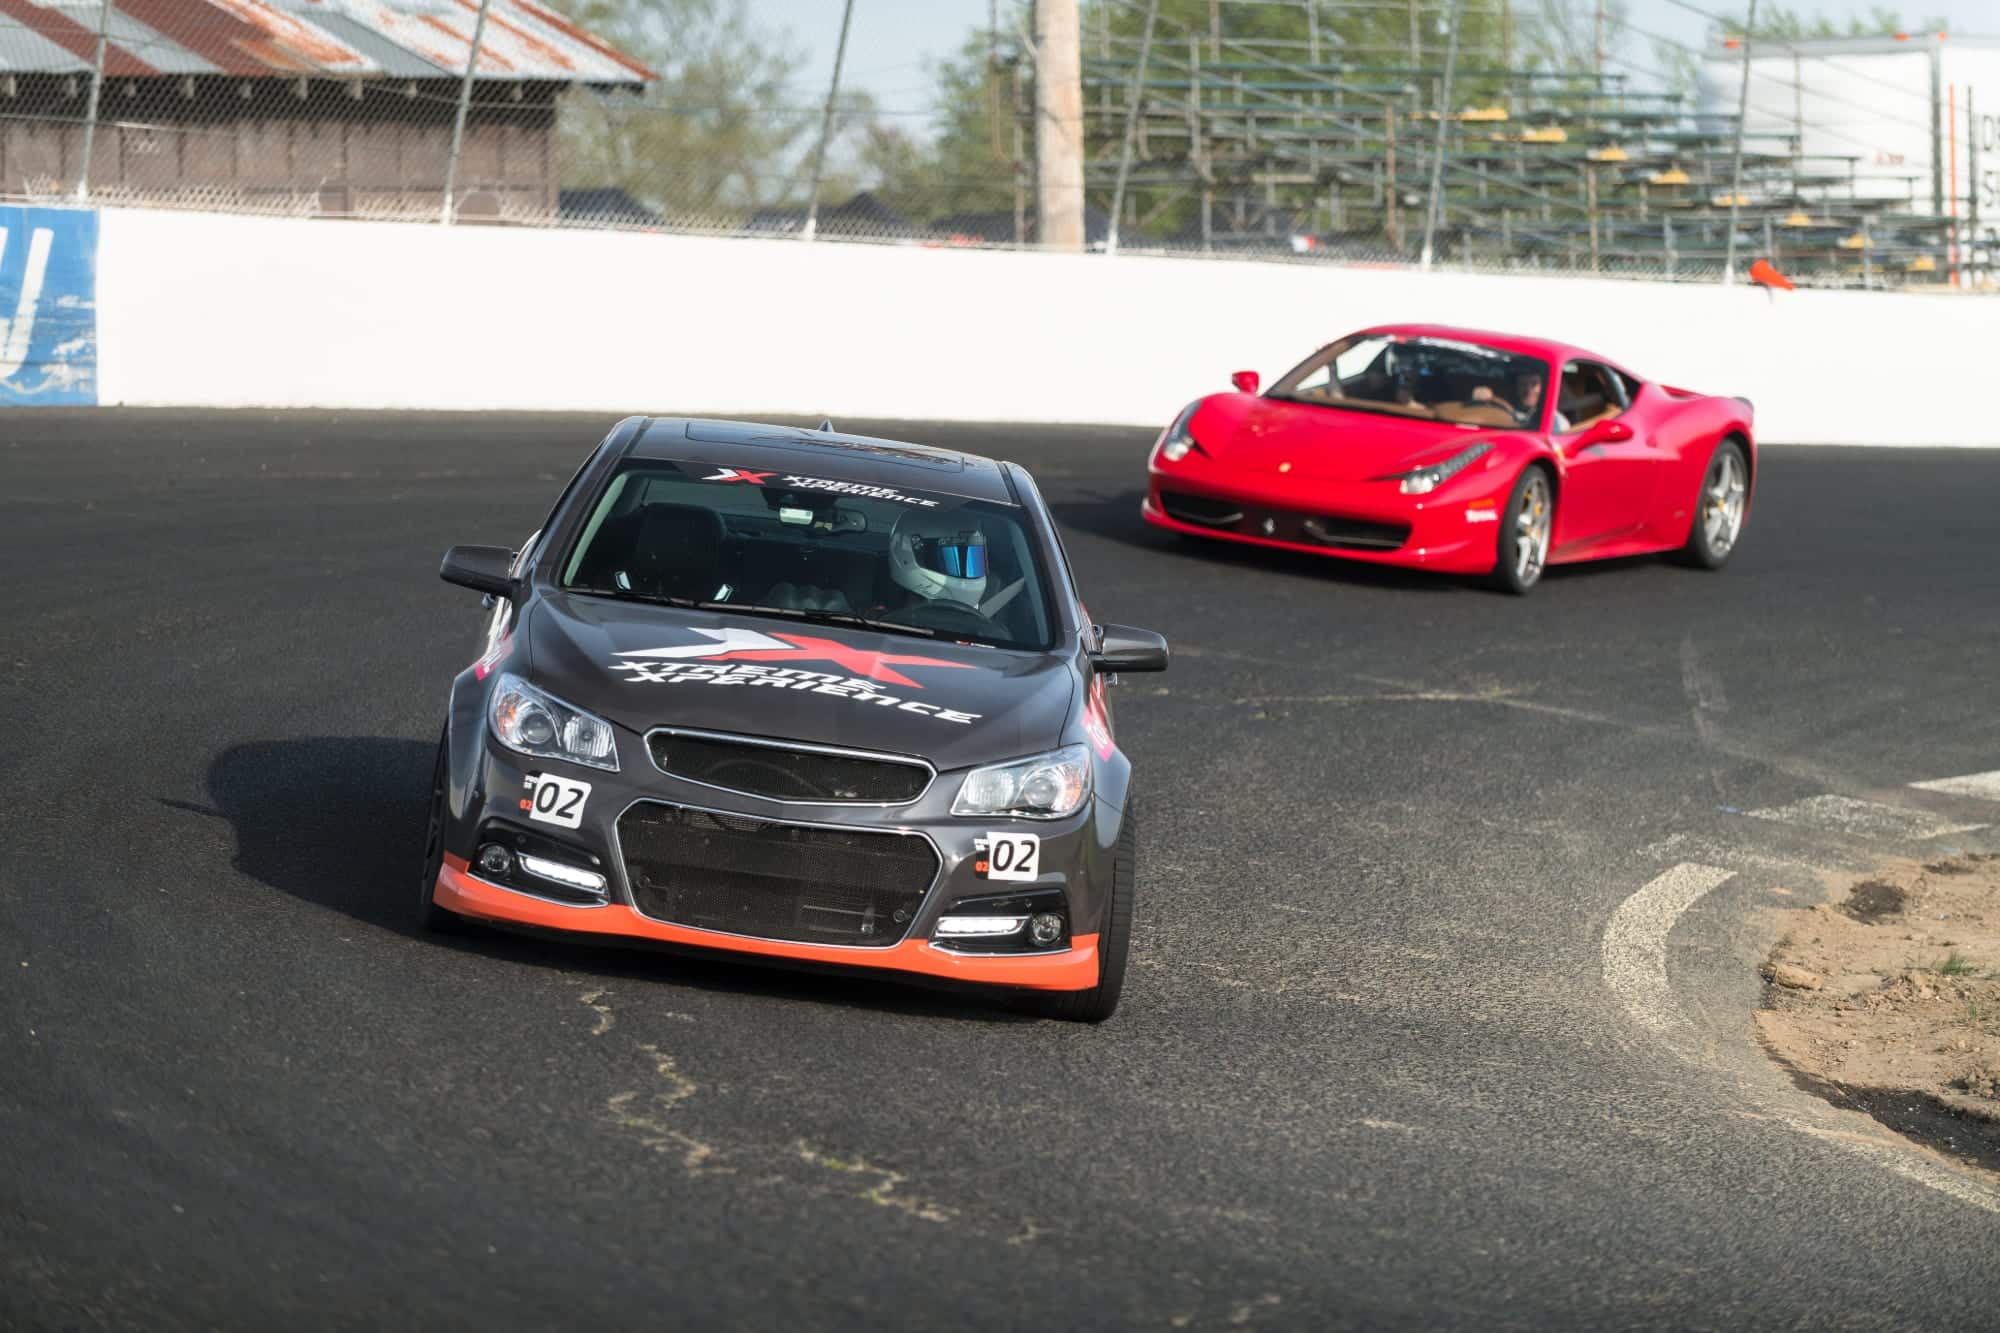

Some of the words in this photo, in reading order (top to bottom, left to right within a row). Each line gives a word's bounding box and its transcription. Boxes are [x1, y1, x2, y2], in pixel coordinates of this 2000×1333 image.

[788, 480, 940, 507] XPERIENCE
[608, 661, 887, 693] XTREME
[624, 671, 983, 725] XPERIENCE
[535, 781, 584, 819] 02
[992, 839, 1036, 873] 02
